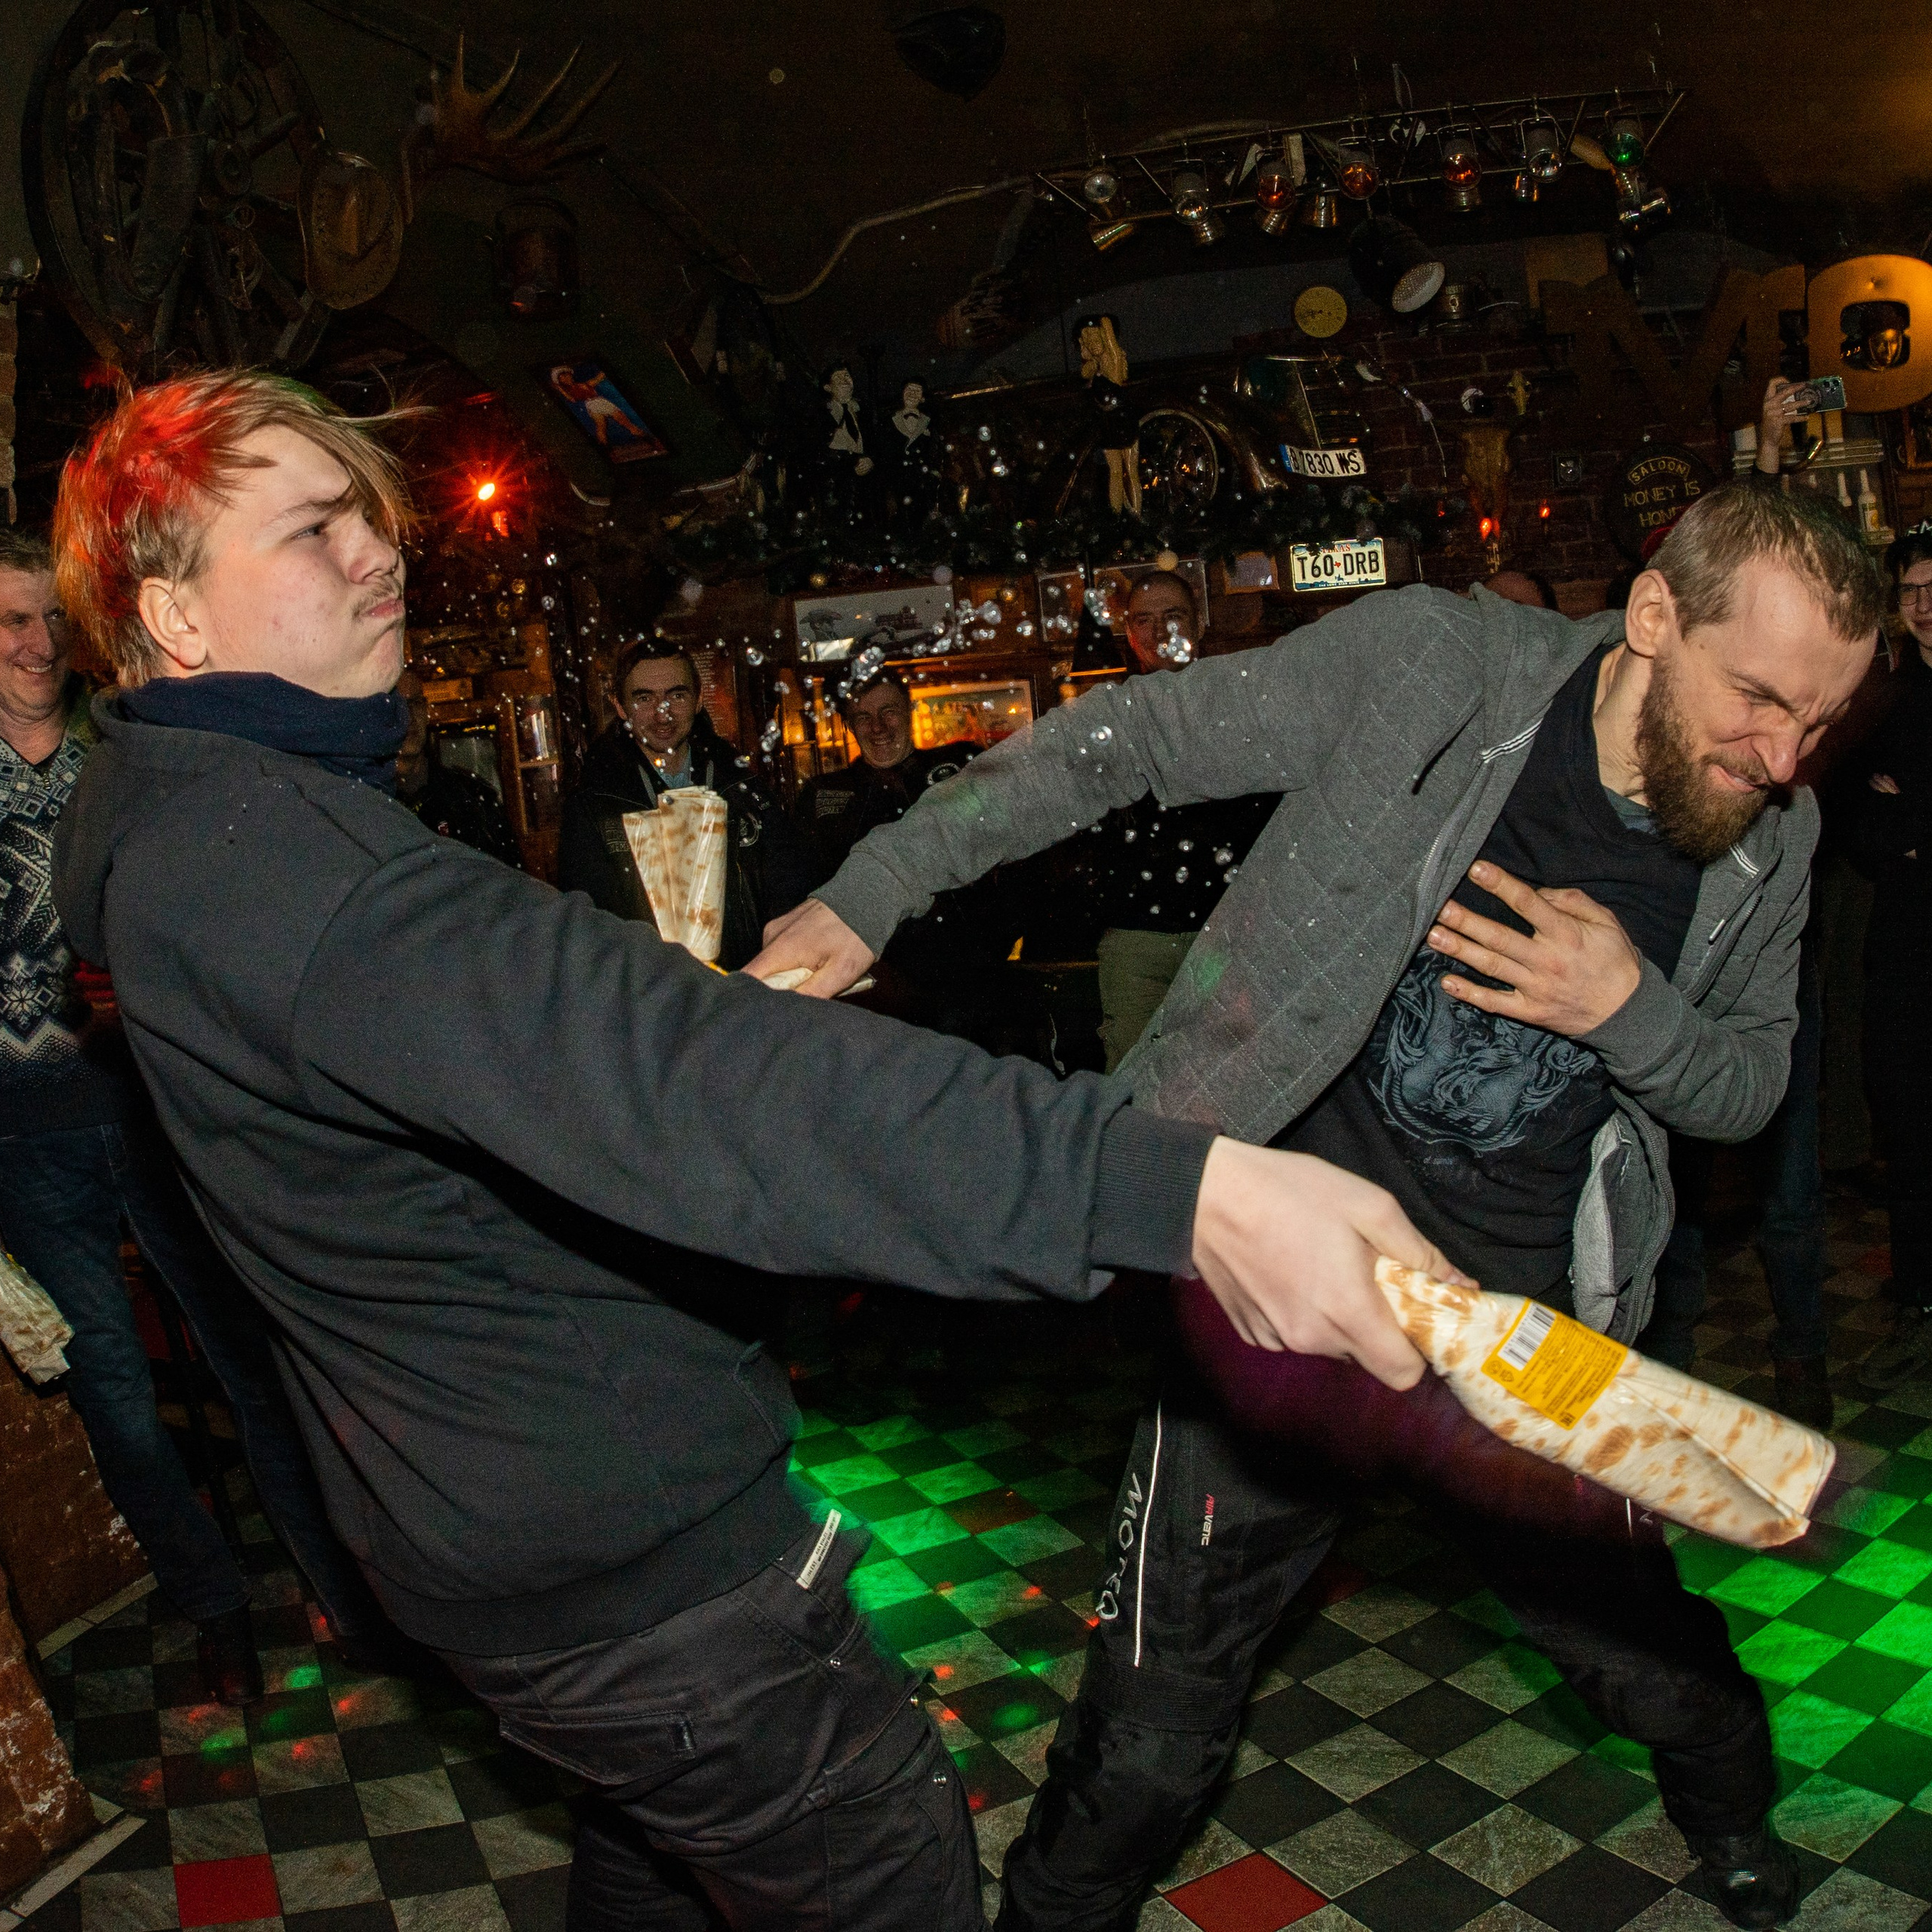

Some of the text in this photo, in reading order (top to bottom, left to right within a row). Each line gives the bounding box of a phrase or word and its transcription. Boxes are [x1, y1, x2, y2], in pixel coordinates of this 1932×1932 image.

[1631, 460, 1686, 481] SALOON
[1624, 480, 1700, 507] MONEY IS
